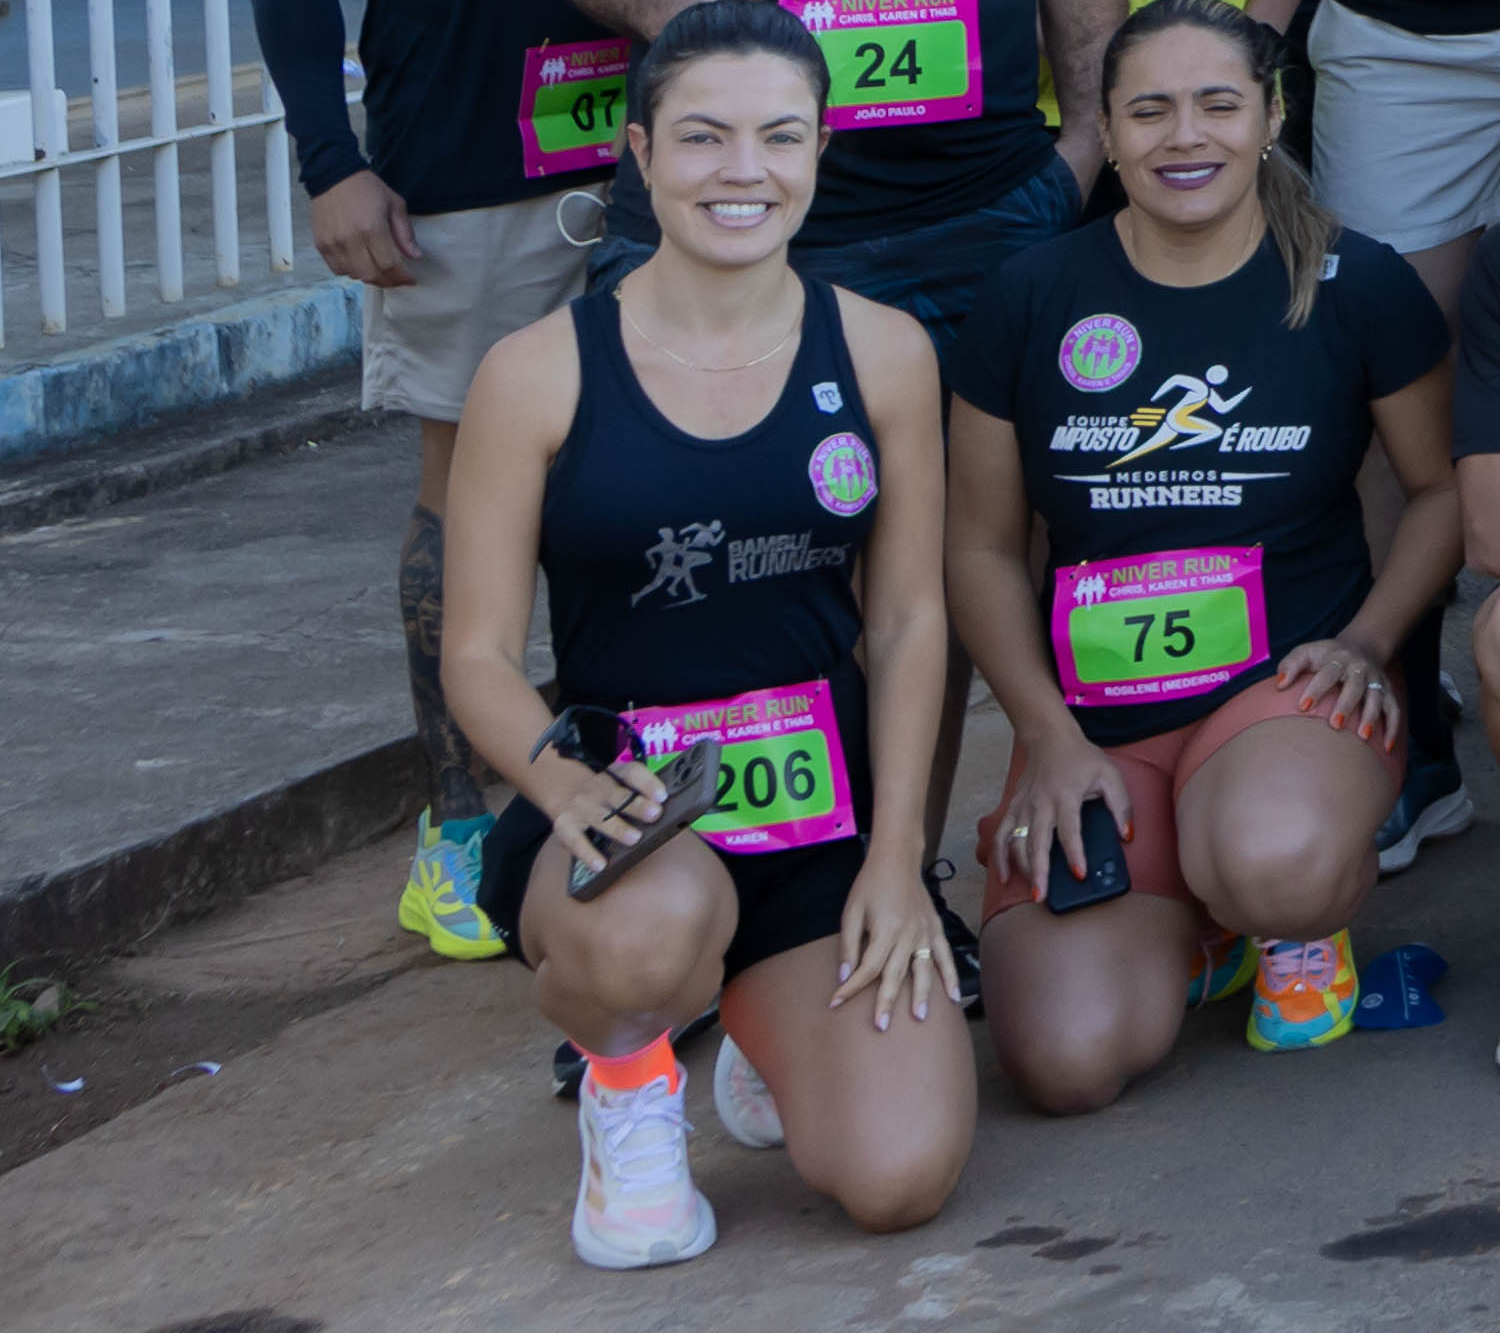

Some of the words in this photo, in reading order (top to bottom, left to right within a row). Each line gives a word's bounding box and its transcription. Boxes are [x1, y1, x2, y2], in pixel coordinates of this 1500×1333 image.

[880, 9, 917, 22] KAREN
[930, 6, 958, 18] THAIS
[855, 39, 922, 89] 24
[890, 105, 926, 118] PAULO
[1067, 415, 1128, 428] EQUIPE
[1049, 426, 1140, 451] IMPOSTO
[1219, 422, 1242, 453] É
[1242, 425, 1312, 451] ROUBO
[1116, 470, 1218, 484] MEDEIROS
[1090, 485, 1243, 510] RUNNERS
[728, 543, 852, 584] RUNNERS
[1112, 560, 1177, 586] NIVER
[1182, 554, 1231, 577] RUN
[1147, 578, 1184, 595] KAREN
[1198, 572, 1234, 587] THAIS
[1123, 609, 1196, 663] 75
[1104, 680, 1161, 698] ROSILENE
[682, 699, 762, 732] NIVER
[766, 695, 810, 716] RUN
[728, 720, 772, 739] KAREN
[782, 713, 815, 729] THAIS
[713, 748, 817, 811] 206
[725, 830, 769, 846] KAREN
